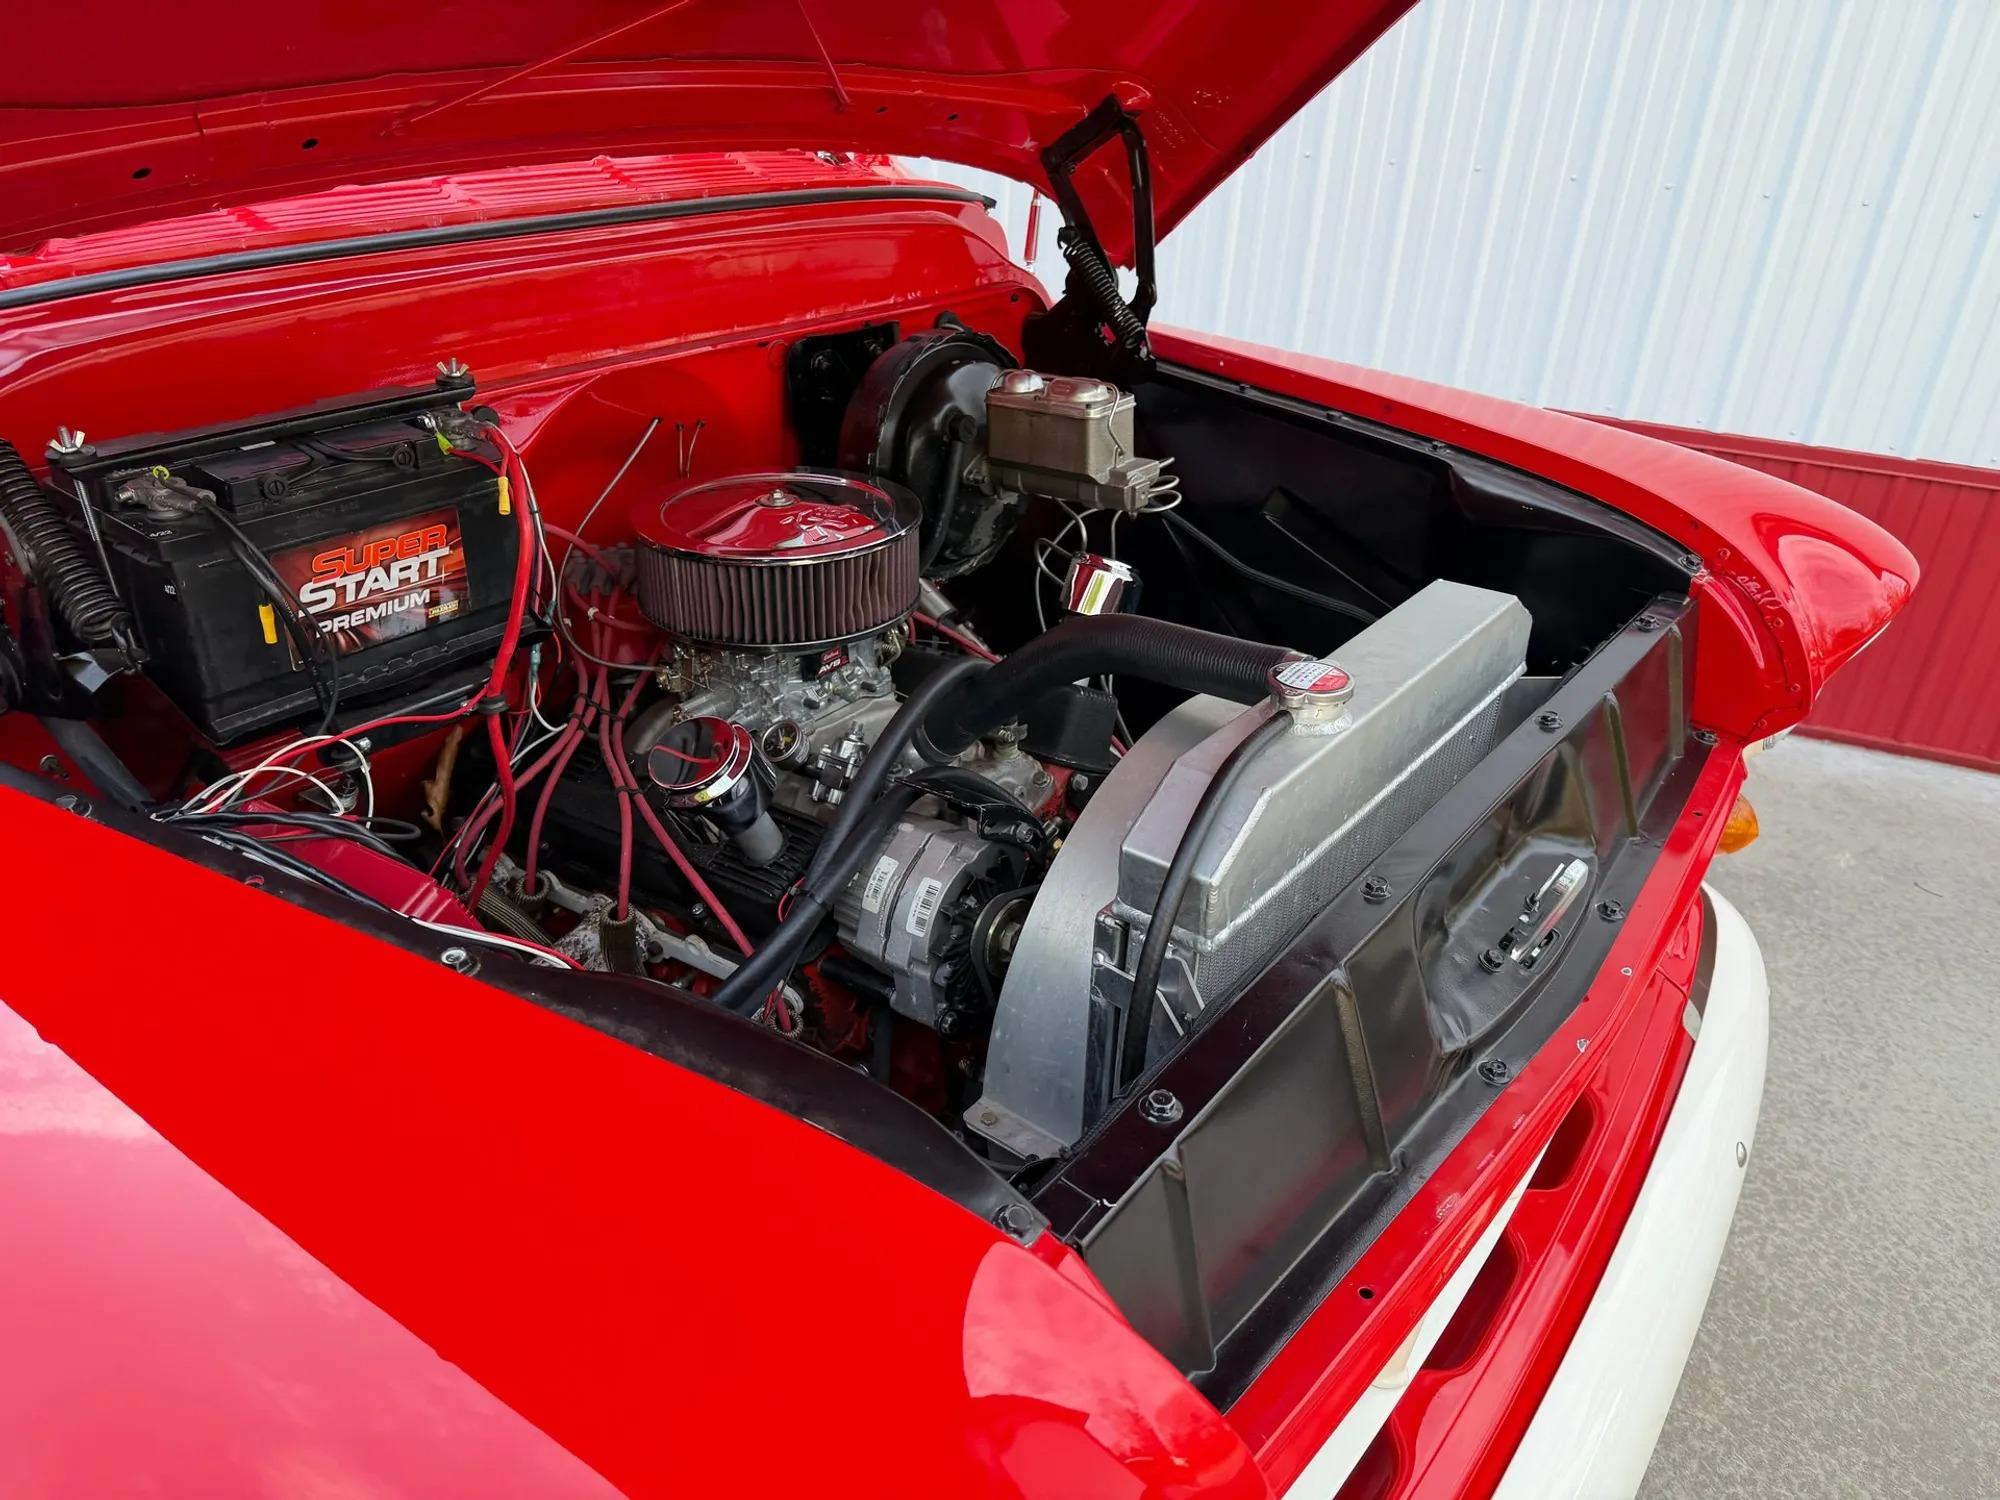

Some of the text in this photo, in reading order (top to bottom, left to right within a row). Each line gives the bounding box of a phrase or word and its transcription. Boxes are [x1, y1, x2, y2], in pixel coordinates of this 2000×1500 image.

[298, 546, 451, 618] START
[312, 524, 447, 584] SUPER
[316, 589, 431, 638] PREMIUM
